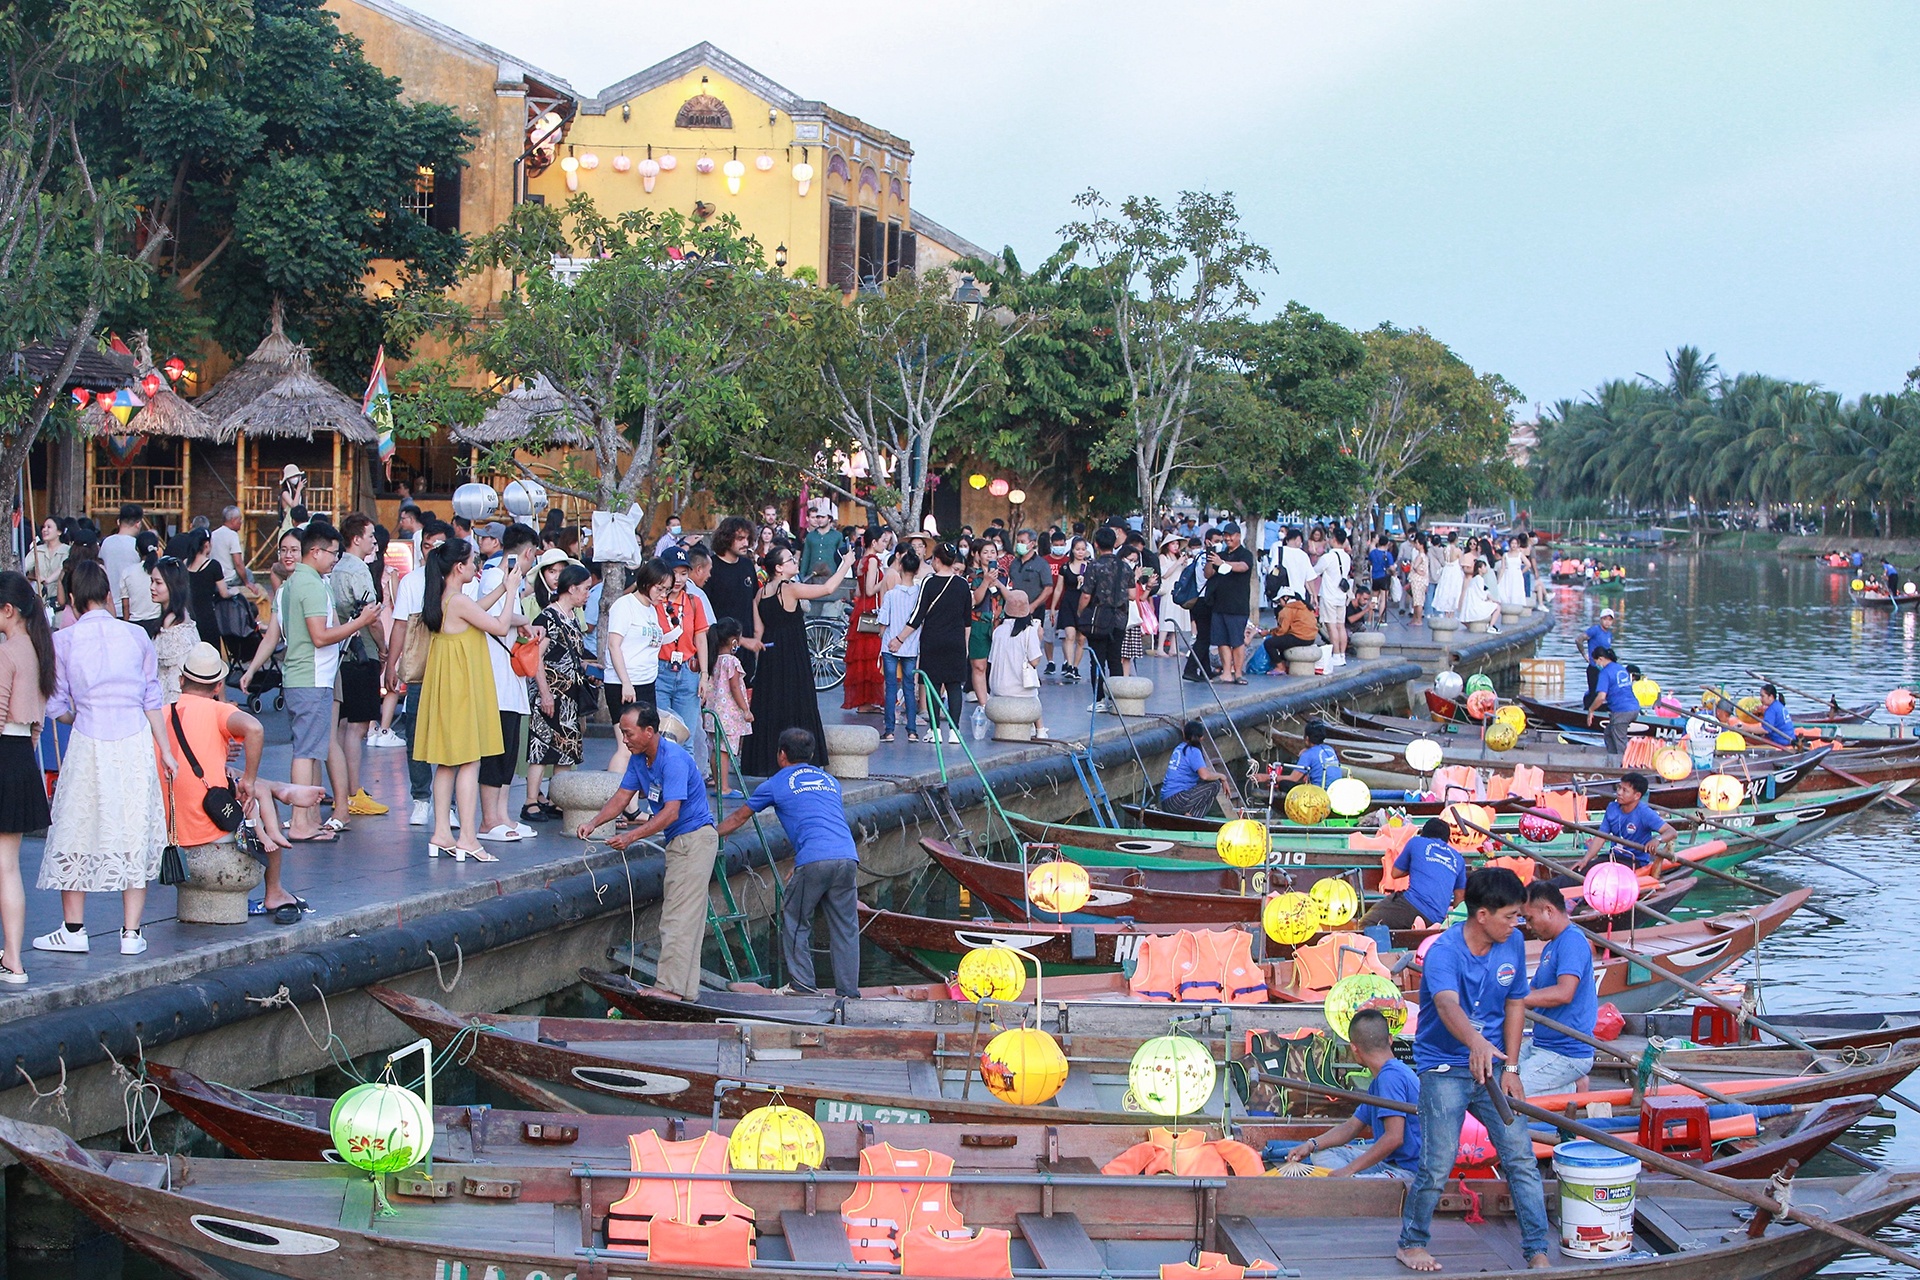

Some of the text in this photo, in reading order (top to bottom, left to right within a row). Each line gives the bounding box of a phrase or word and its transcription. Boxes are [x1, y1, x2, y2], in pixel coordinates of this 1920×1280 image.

[1269, 851, 1307, 866] 219
[827, 1101, 921, 1124] HA 271
